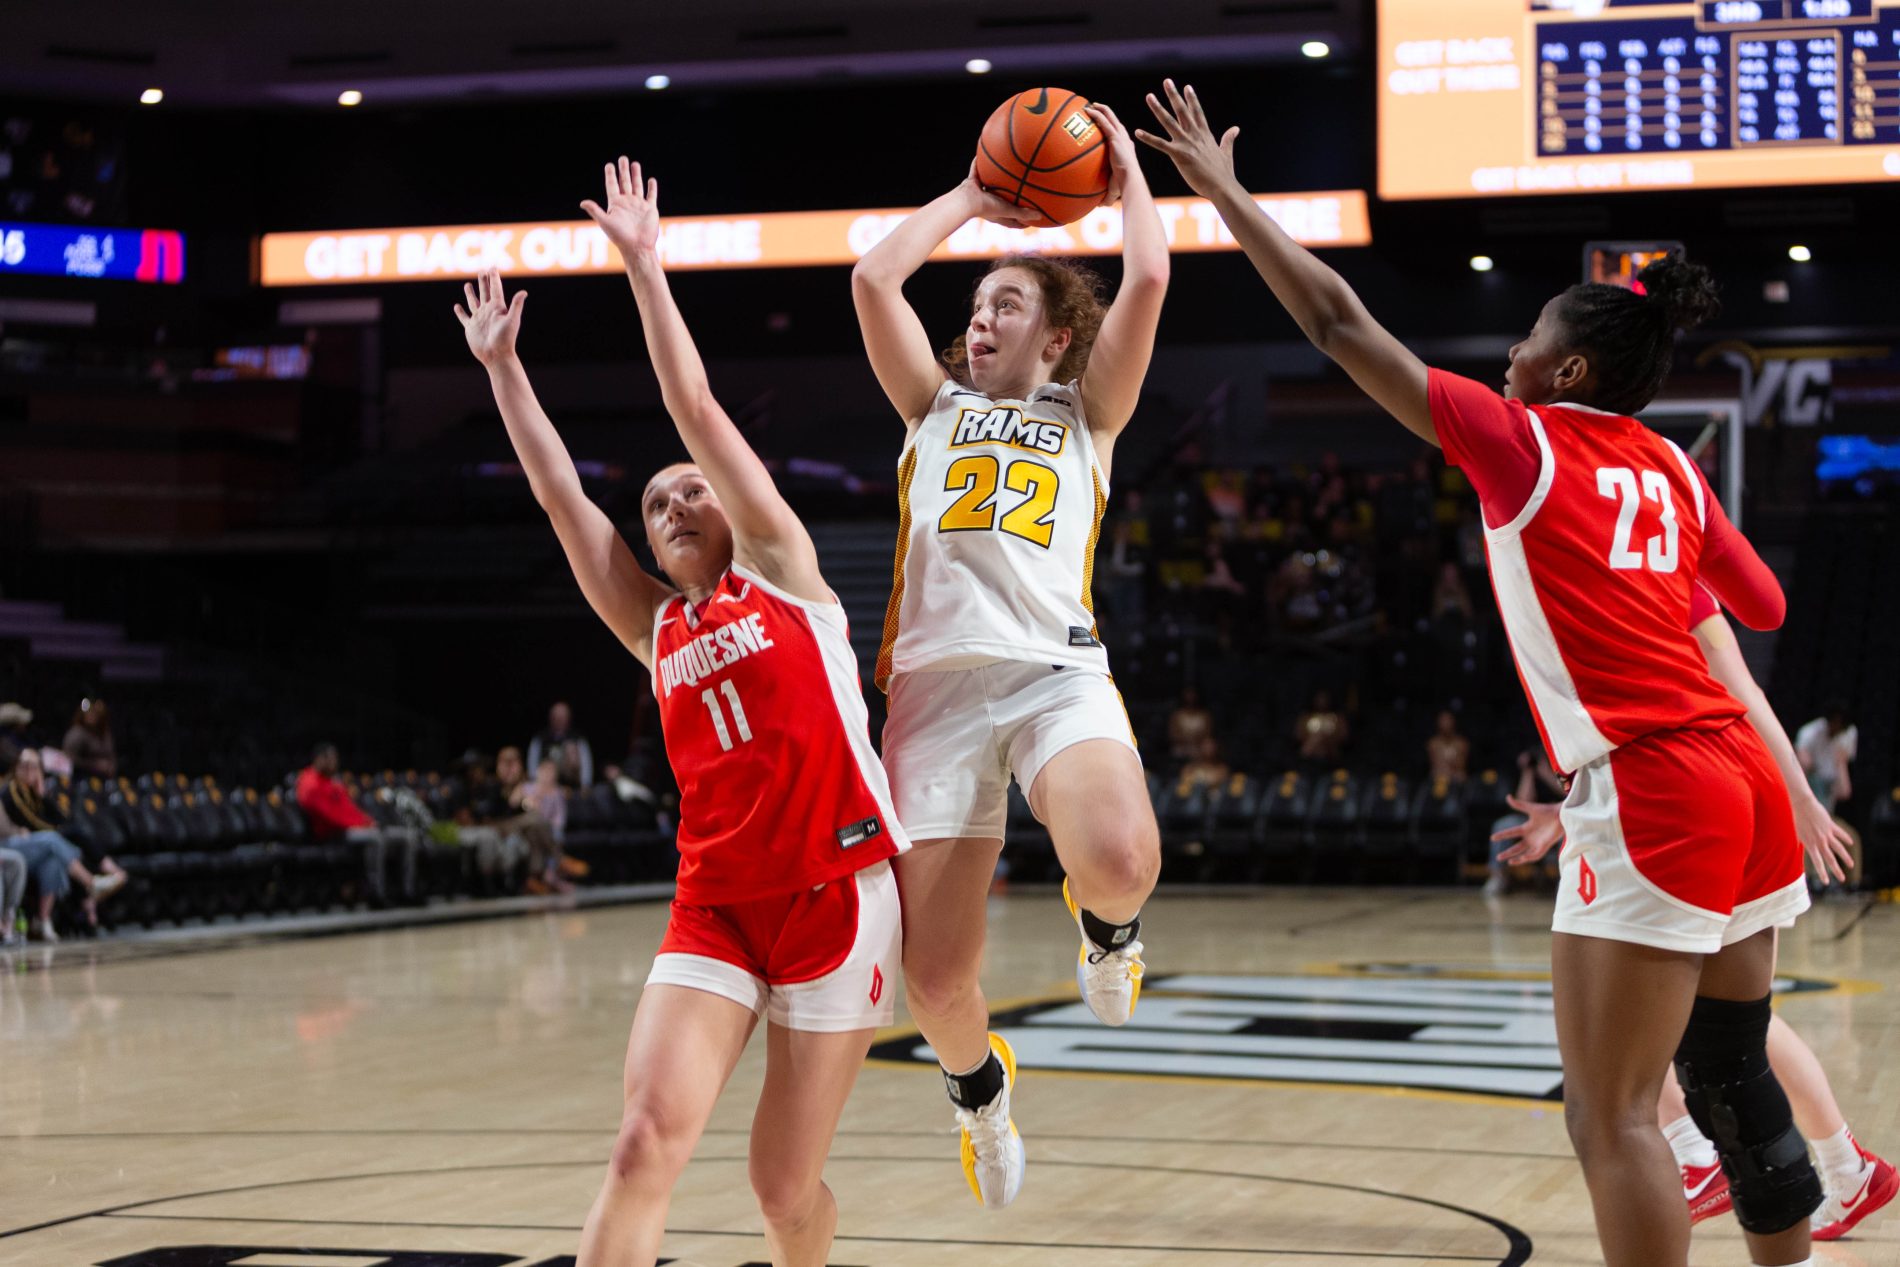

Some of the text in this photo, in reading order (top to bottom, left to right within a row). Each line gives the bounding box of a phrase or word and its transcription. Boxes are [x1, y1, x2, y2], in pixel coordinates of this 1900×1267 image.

[305, 220, 761, 278] GET BACK OUT HERE
[1081, 203, 1184, 250] OT
[1723, 350, 1834, 427] VC
[948, 405, 1070, 458] RAMS
[938, 454, 1060, 549] 22
[1596, 467, 1679, 573] 23
[659, 611, 774, 698] DUQUESNE
[701, 678, 753, 752] 11
